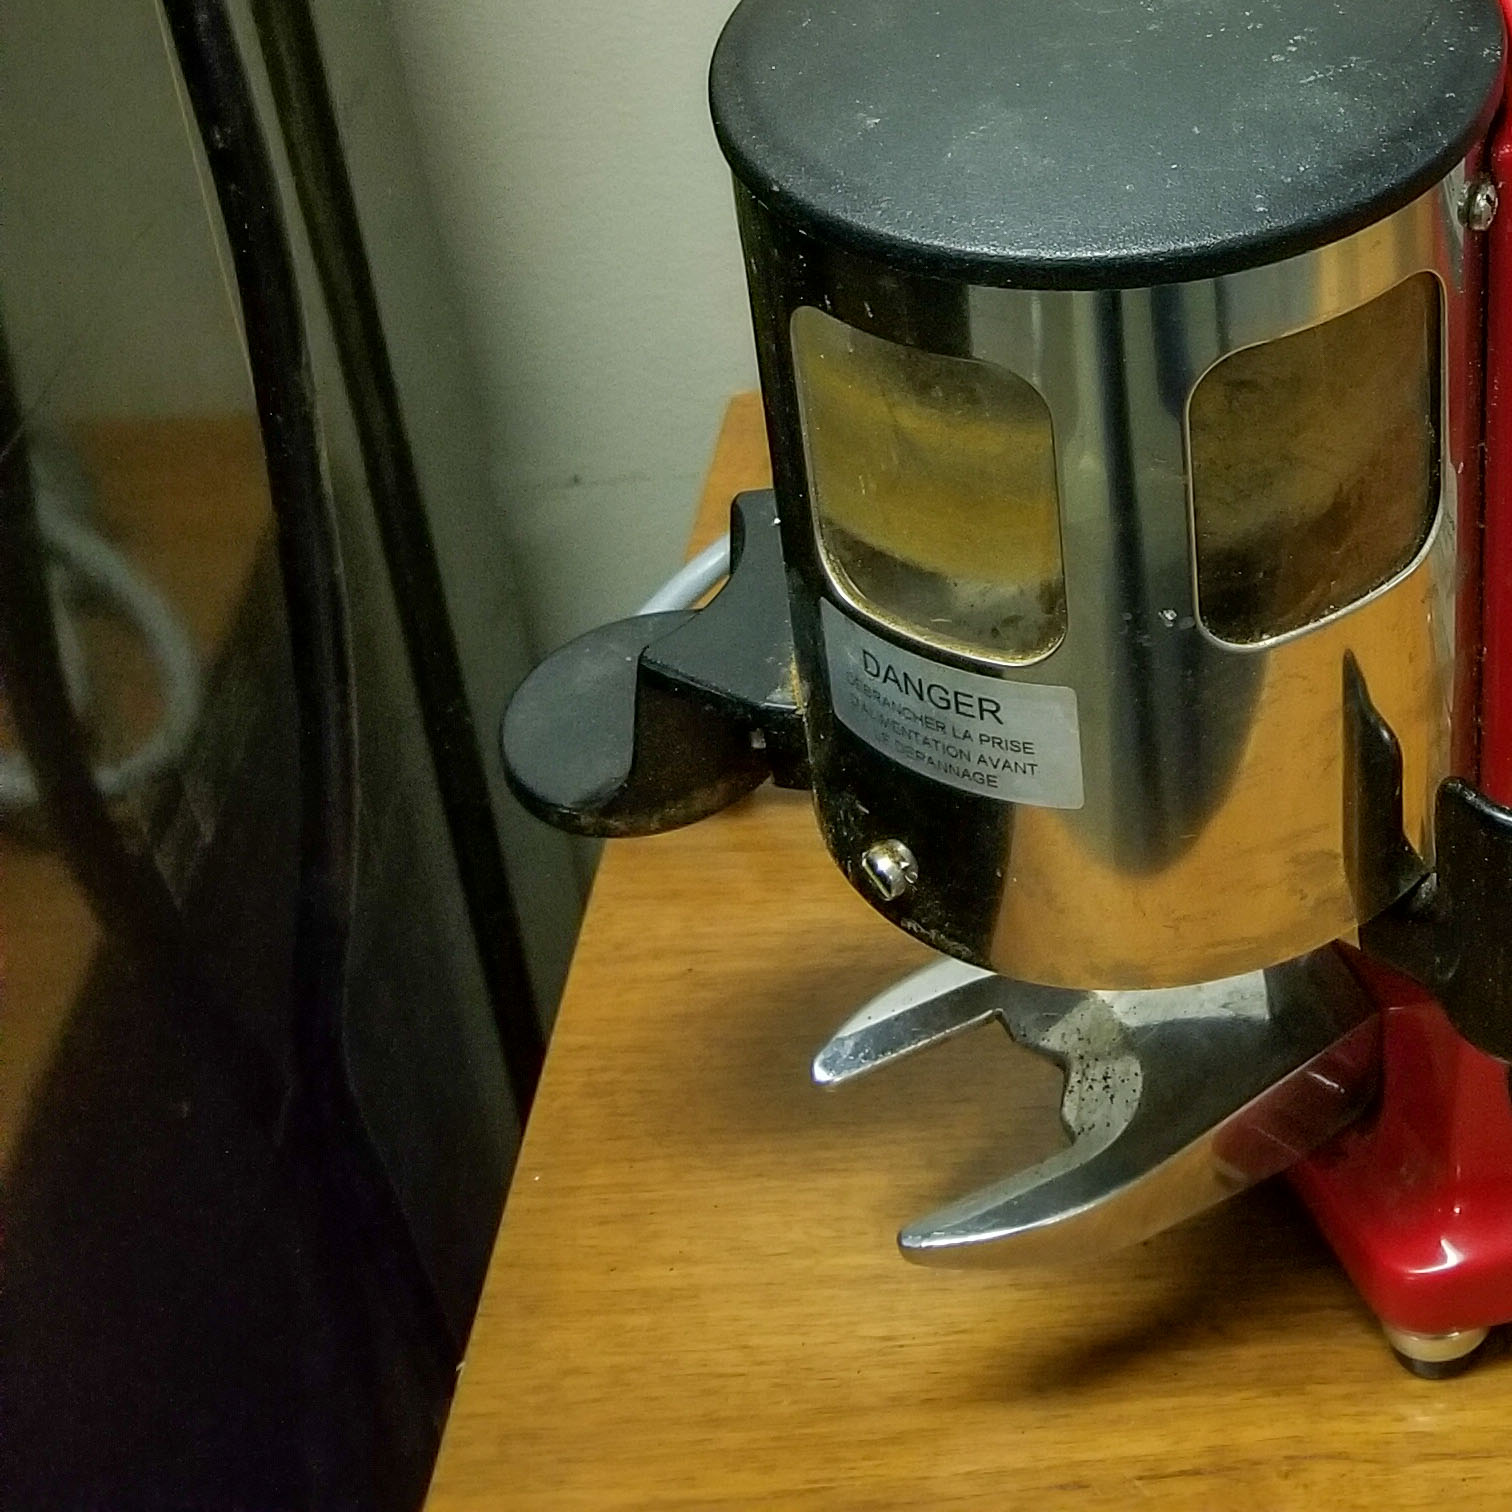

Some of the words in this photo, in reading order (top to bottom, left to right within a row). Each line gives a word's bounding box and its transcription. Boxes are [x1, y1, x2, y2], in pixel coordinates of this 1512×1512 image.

[862, 648, 1004, 725] DANGER
[952, 726, 974, 743] LA
[979, 733, 1035, 755] PRISE
[977, 753, 1038, 776] AVANT
